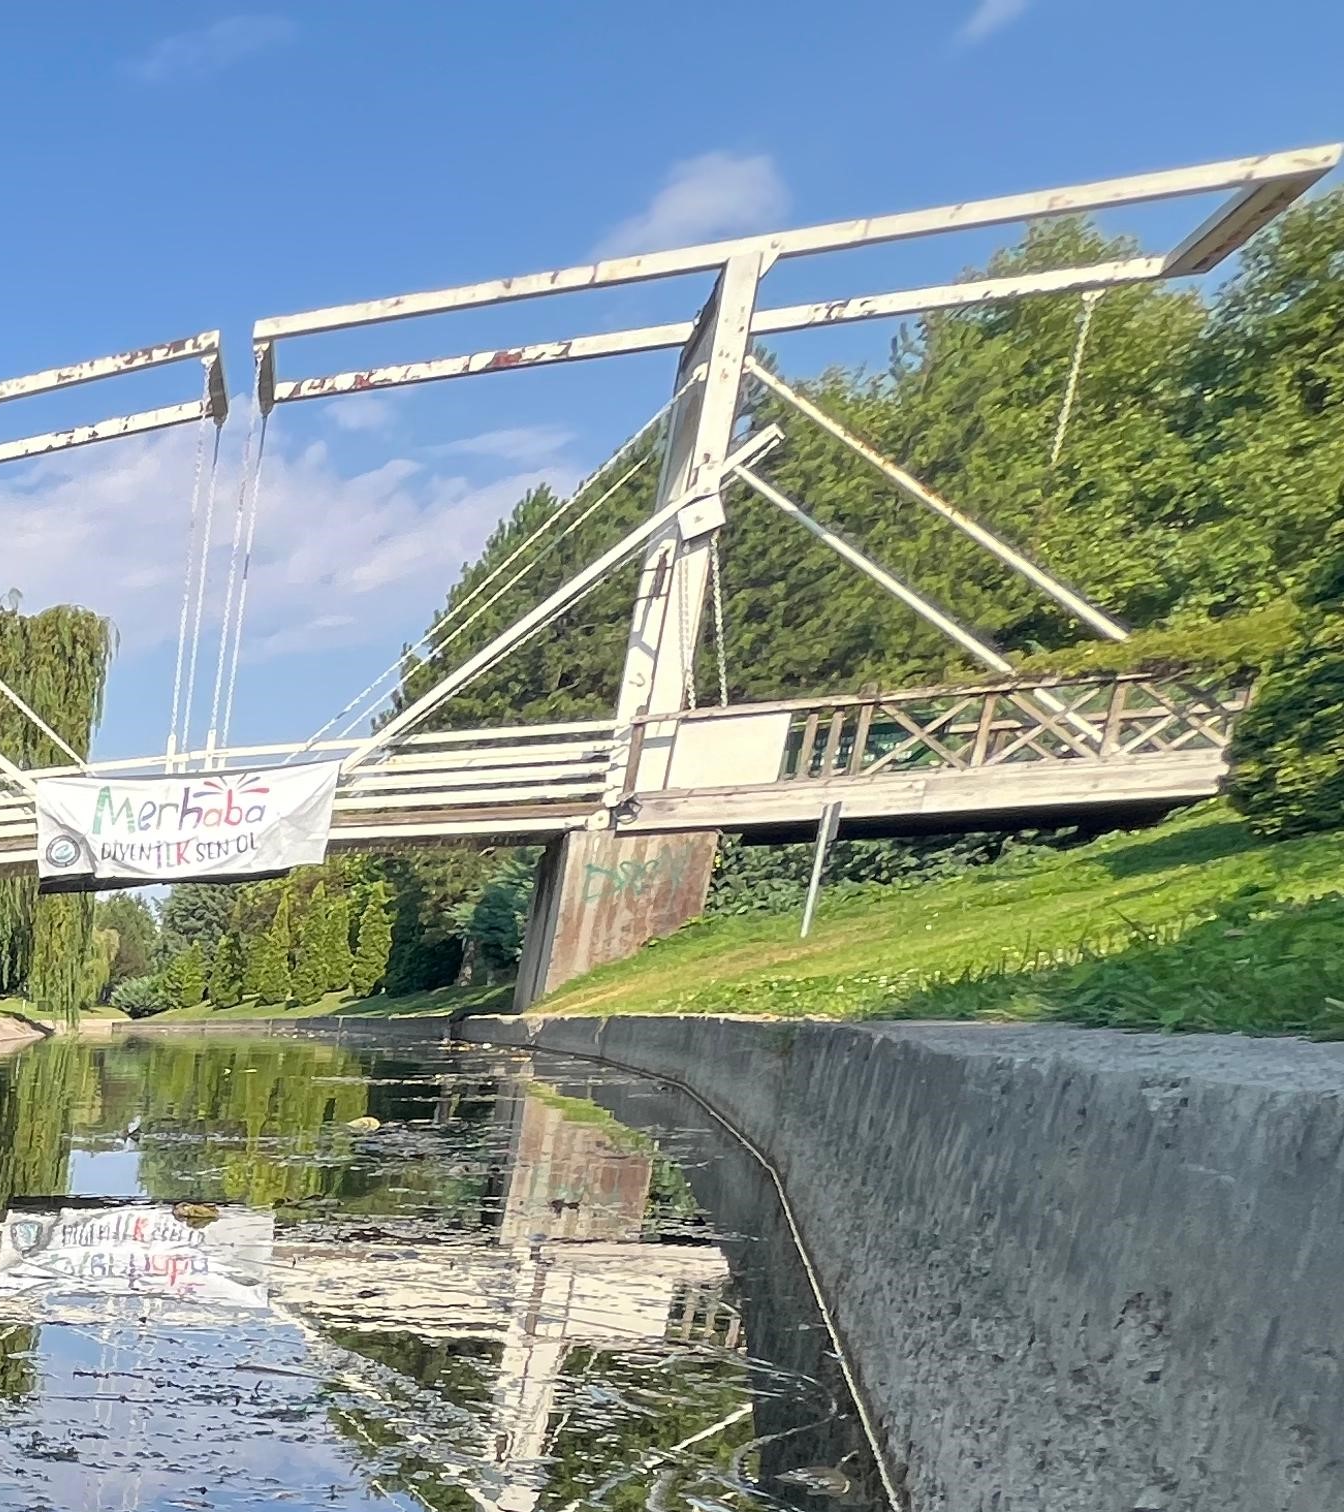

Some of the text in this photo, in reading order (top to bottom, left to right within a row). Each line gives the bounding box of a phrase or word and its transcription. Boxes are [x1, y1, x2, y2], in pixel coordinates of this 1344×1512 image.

[92, 785, 266, 834] Merhaba
[196, 840, 229, 862] SEN
[236, 832, 258, 853] OL
